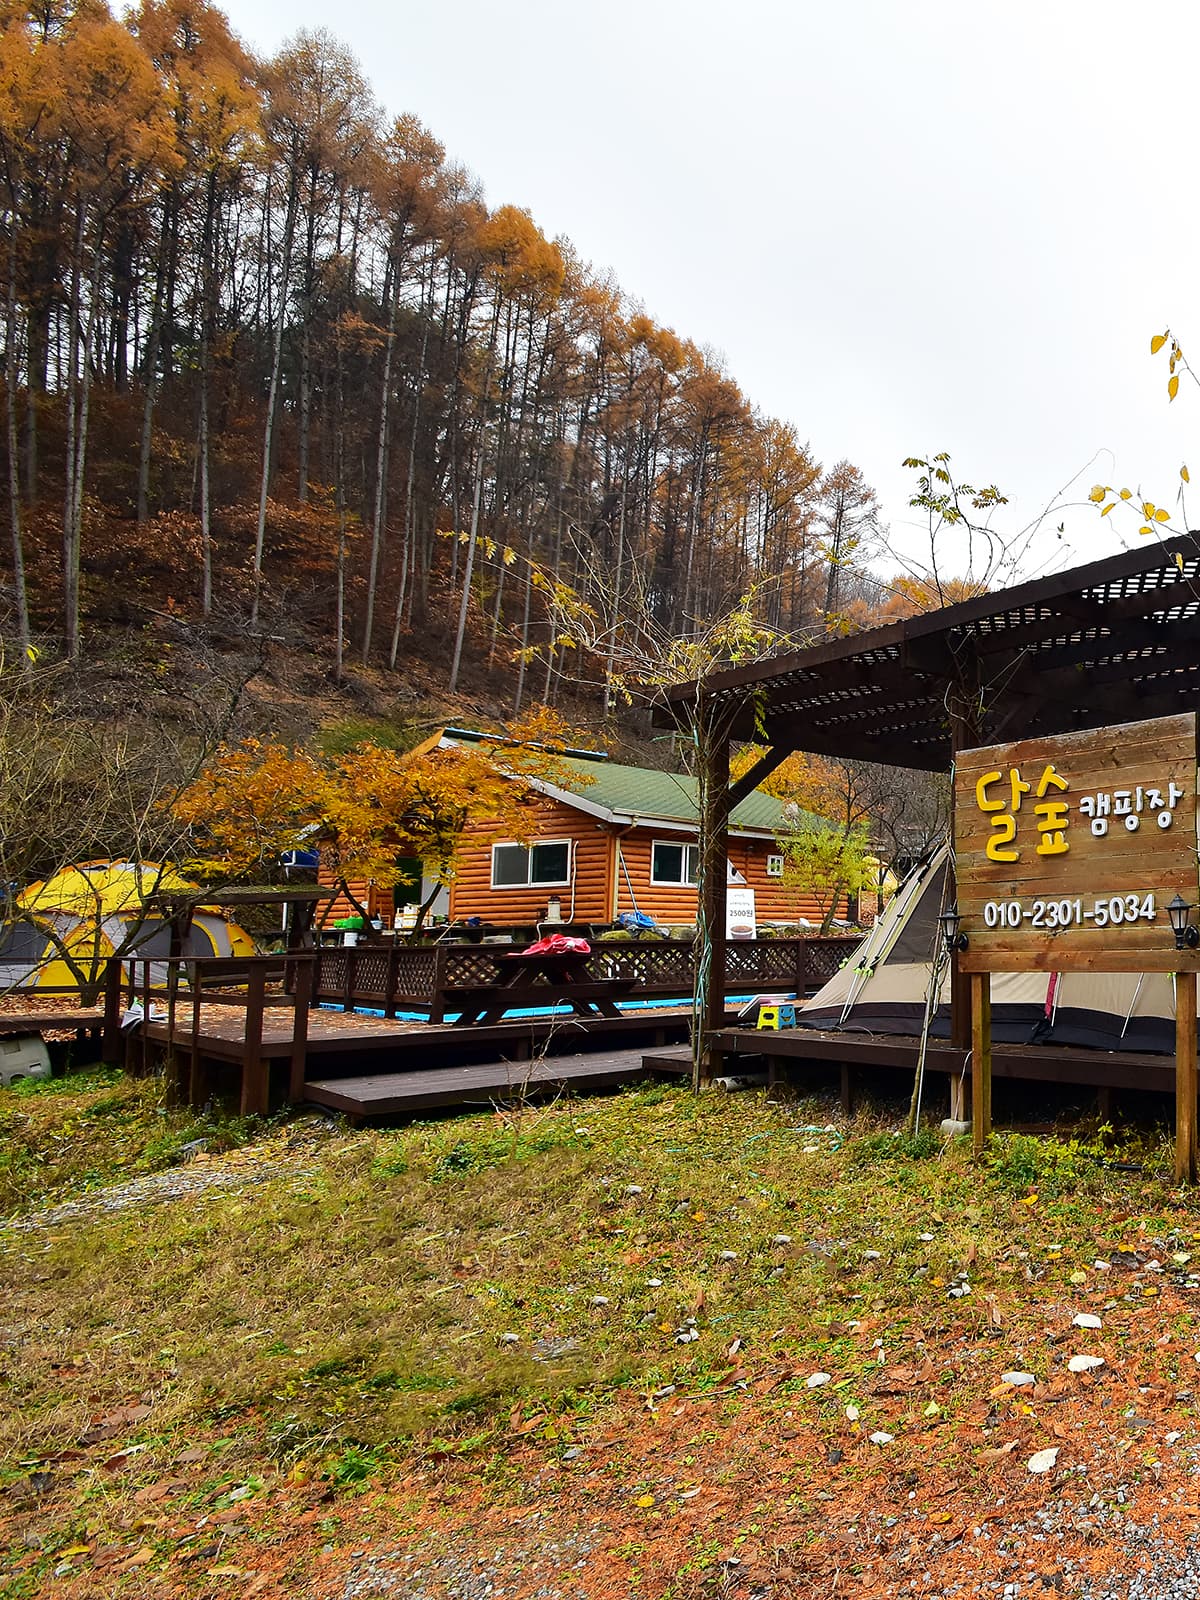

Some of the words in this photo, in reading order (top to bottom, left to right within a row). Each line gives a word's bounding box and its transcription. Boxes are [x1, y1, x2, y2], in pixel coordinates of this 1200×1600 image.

[975, 764, 1071, 863] 달숲
[1079, 782, 1184, 836] 캠핑장
[729, 909, 753, 918] 2500원
[983, 893, 1157, 928] 010-2301-5034
